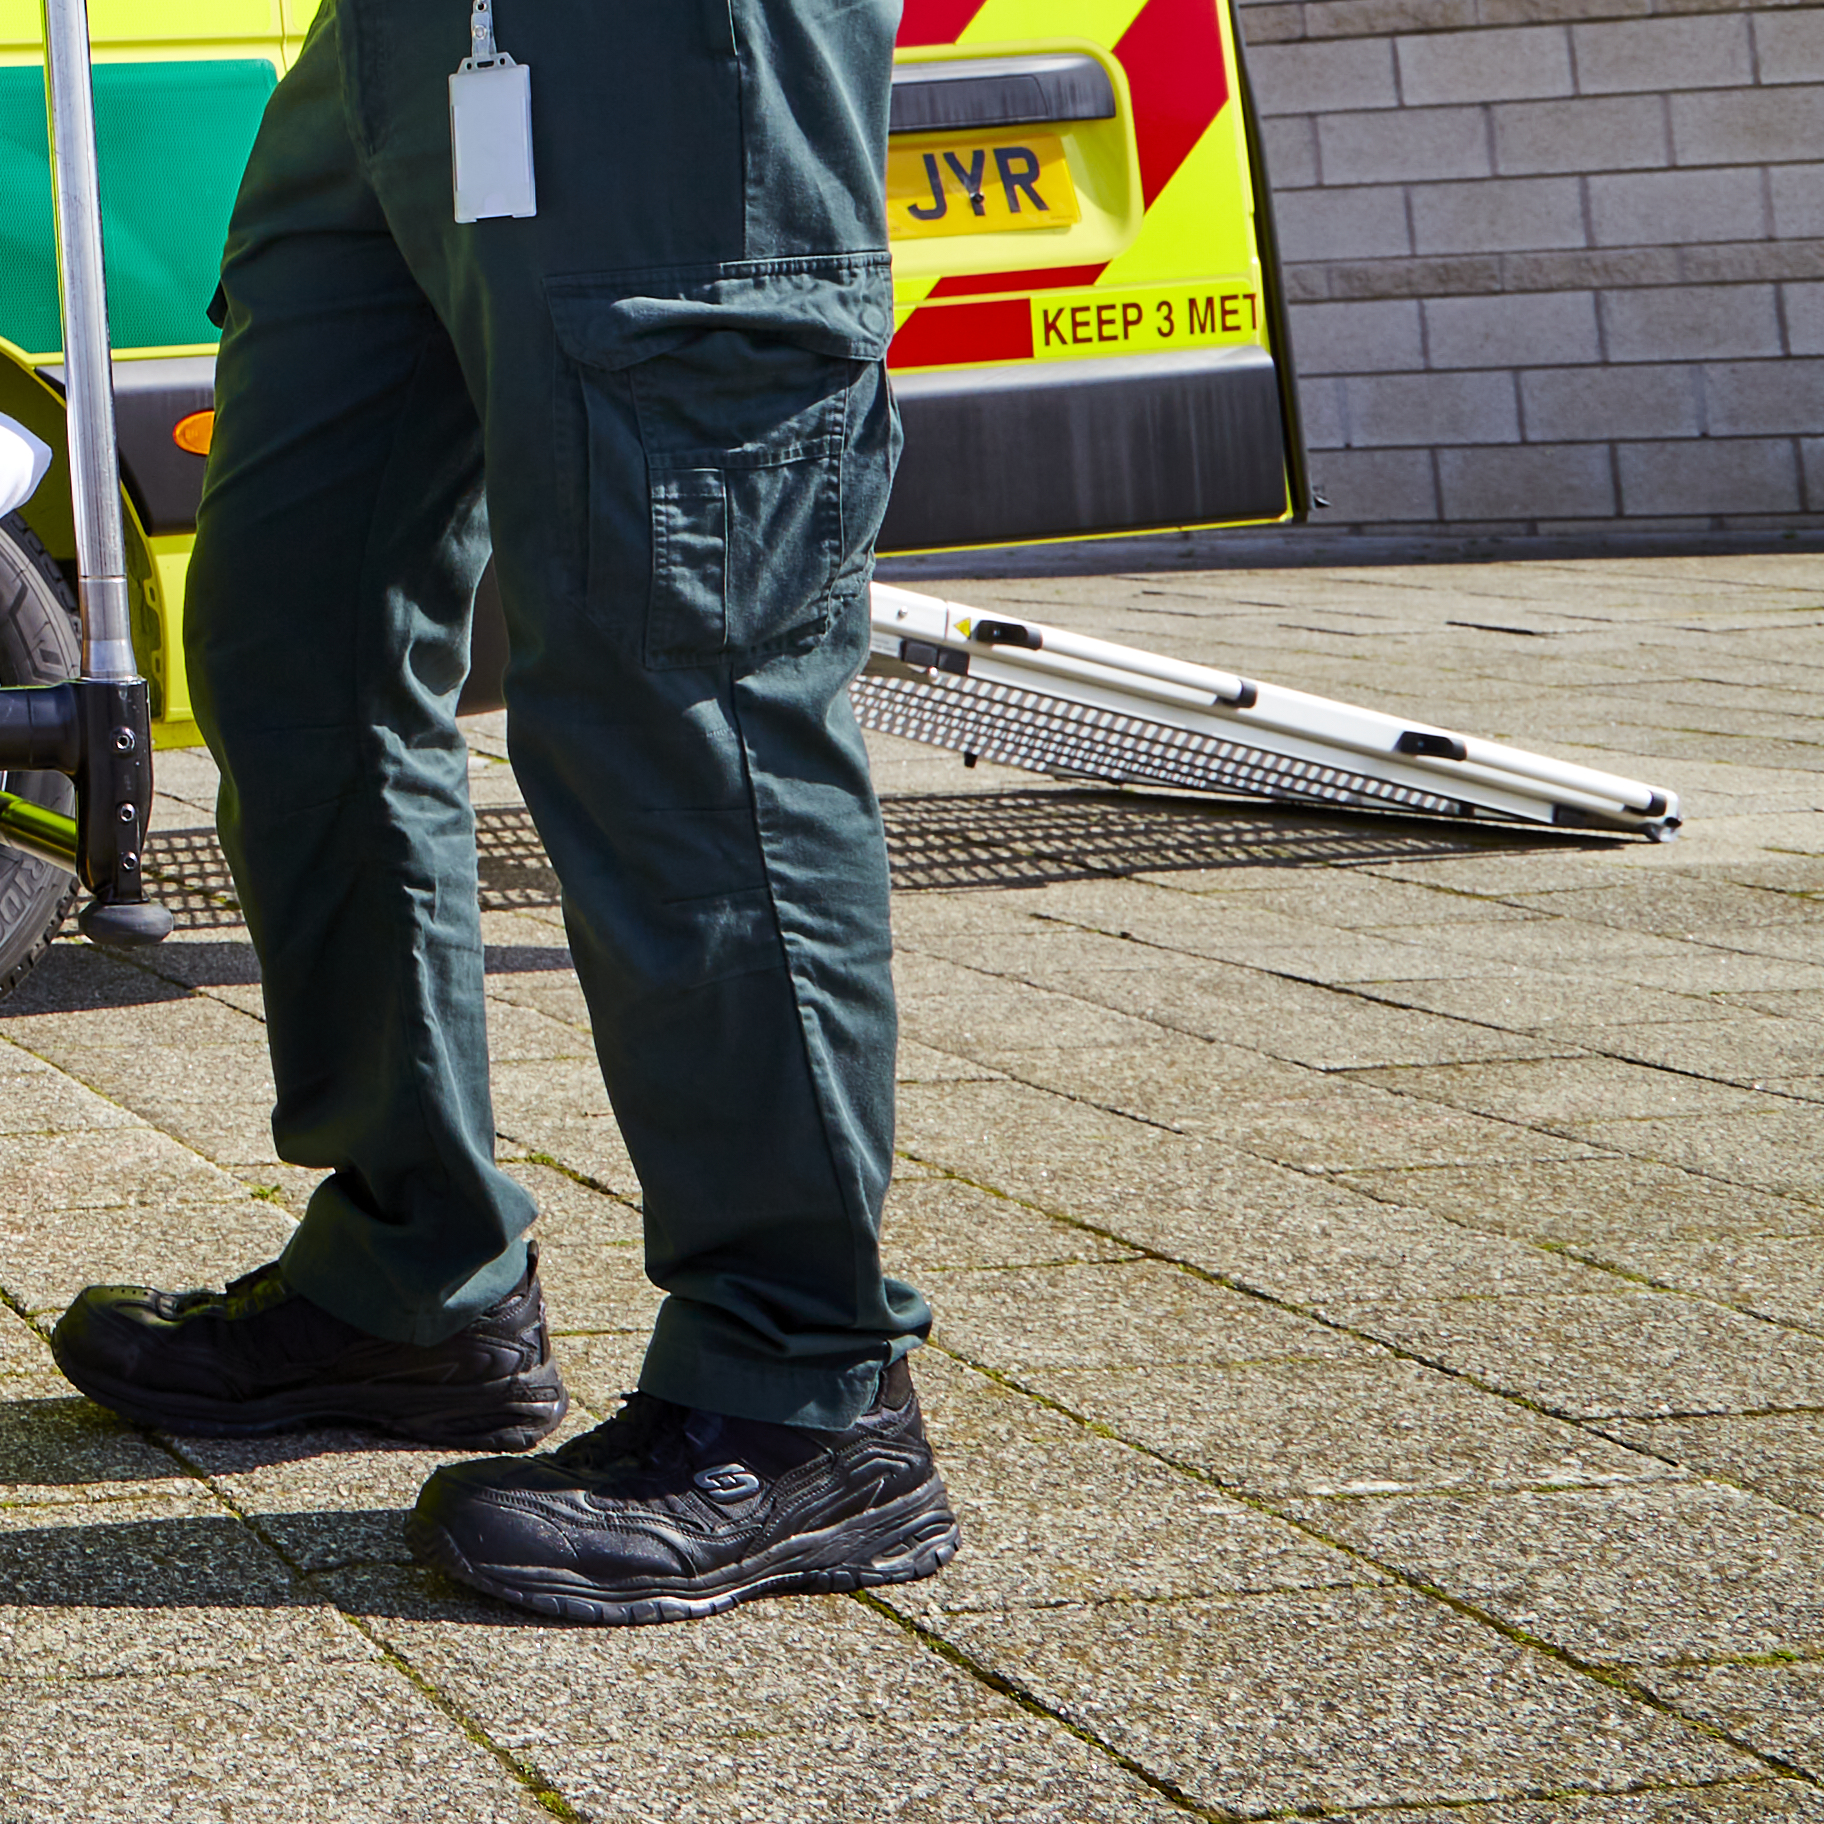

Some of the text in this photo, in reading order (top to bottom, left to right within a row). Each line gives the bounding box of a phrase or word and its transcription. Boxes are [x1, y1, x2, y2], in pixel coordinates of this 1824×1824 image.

[907, 146, 1051, 221] JYR
[1042, 293, 1258, 347] KEEP 3 MET
